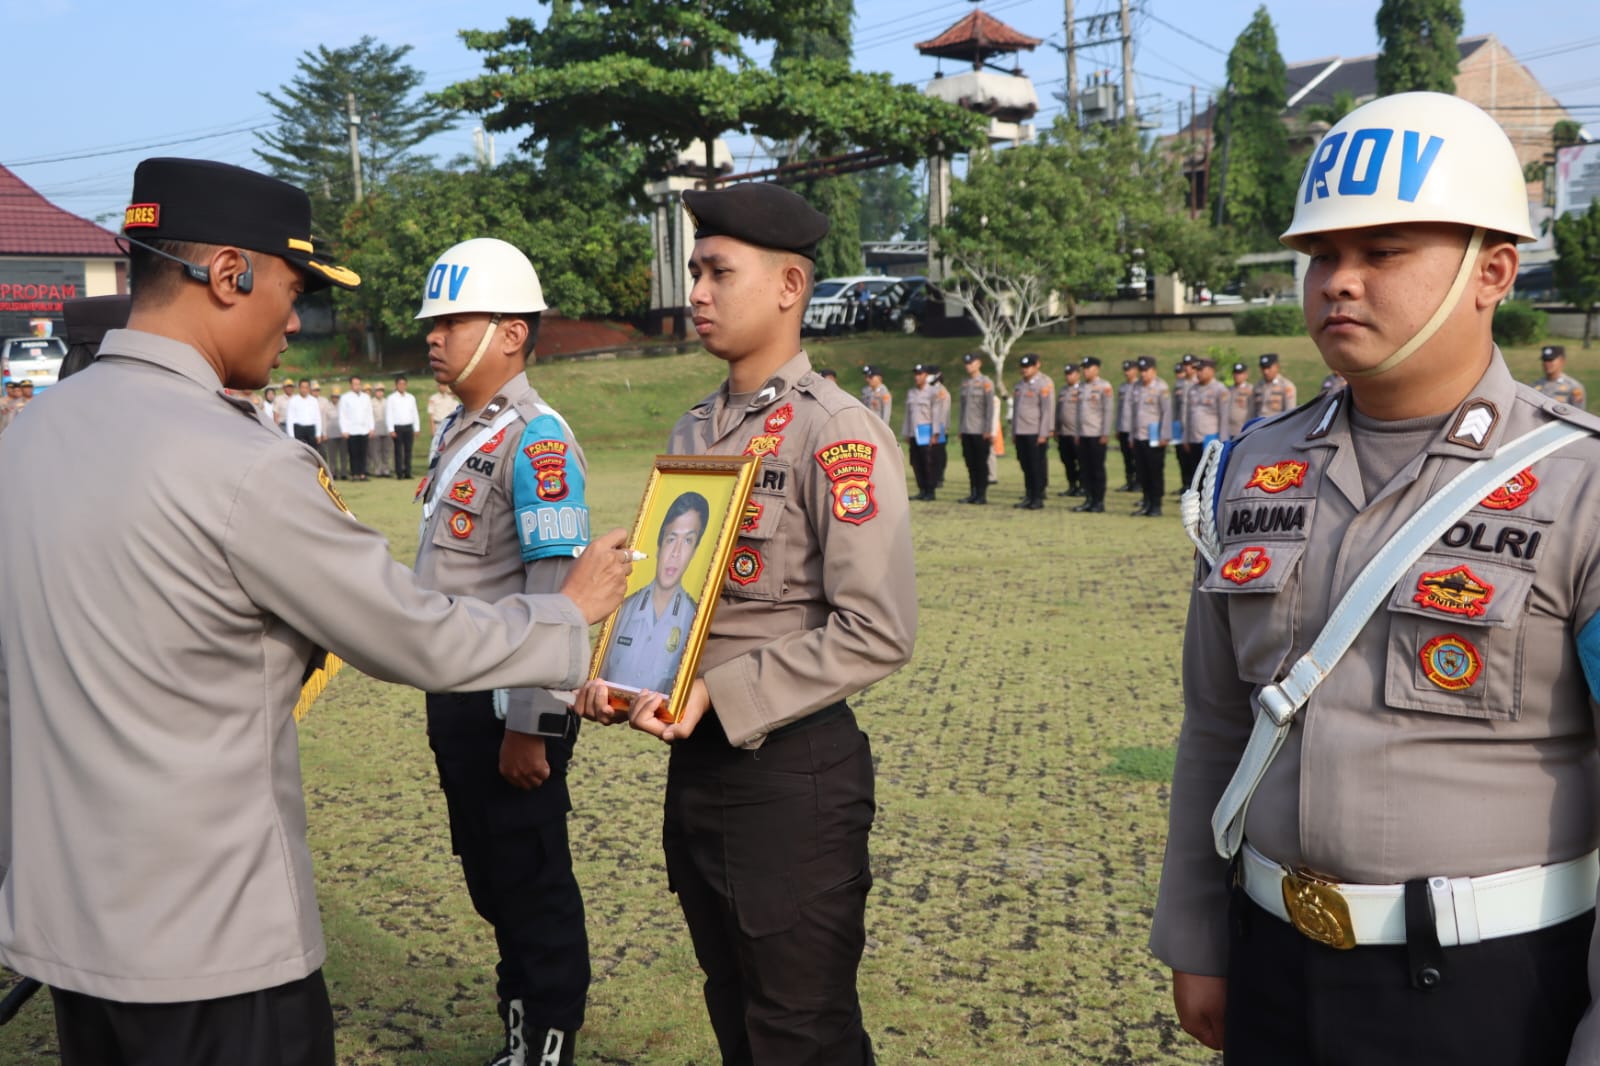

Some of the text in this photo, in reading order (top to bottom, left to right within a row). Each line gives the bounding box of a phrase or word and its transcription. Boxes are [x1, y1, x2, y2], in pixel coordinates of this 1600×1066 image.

[1302, 128, 1445, 205] ROV
[0, 283, 76, 300] PROPAM
[427, 264, 470, 301] OV
[821, 443, 872, 461] POLRES
[466, 457, 495, 477] OLRI
[832, 465, 868, 477] LAMPUNG
[520, 506, 588, 545] PROV
[1227, 505, 1305, 537] ARJUNA
[1442, 520, 1541, 561] OLRI
[1428, 591, 1474, 609] SNIPER
